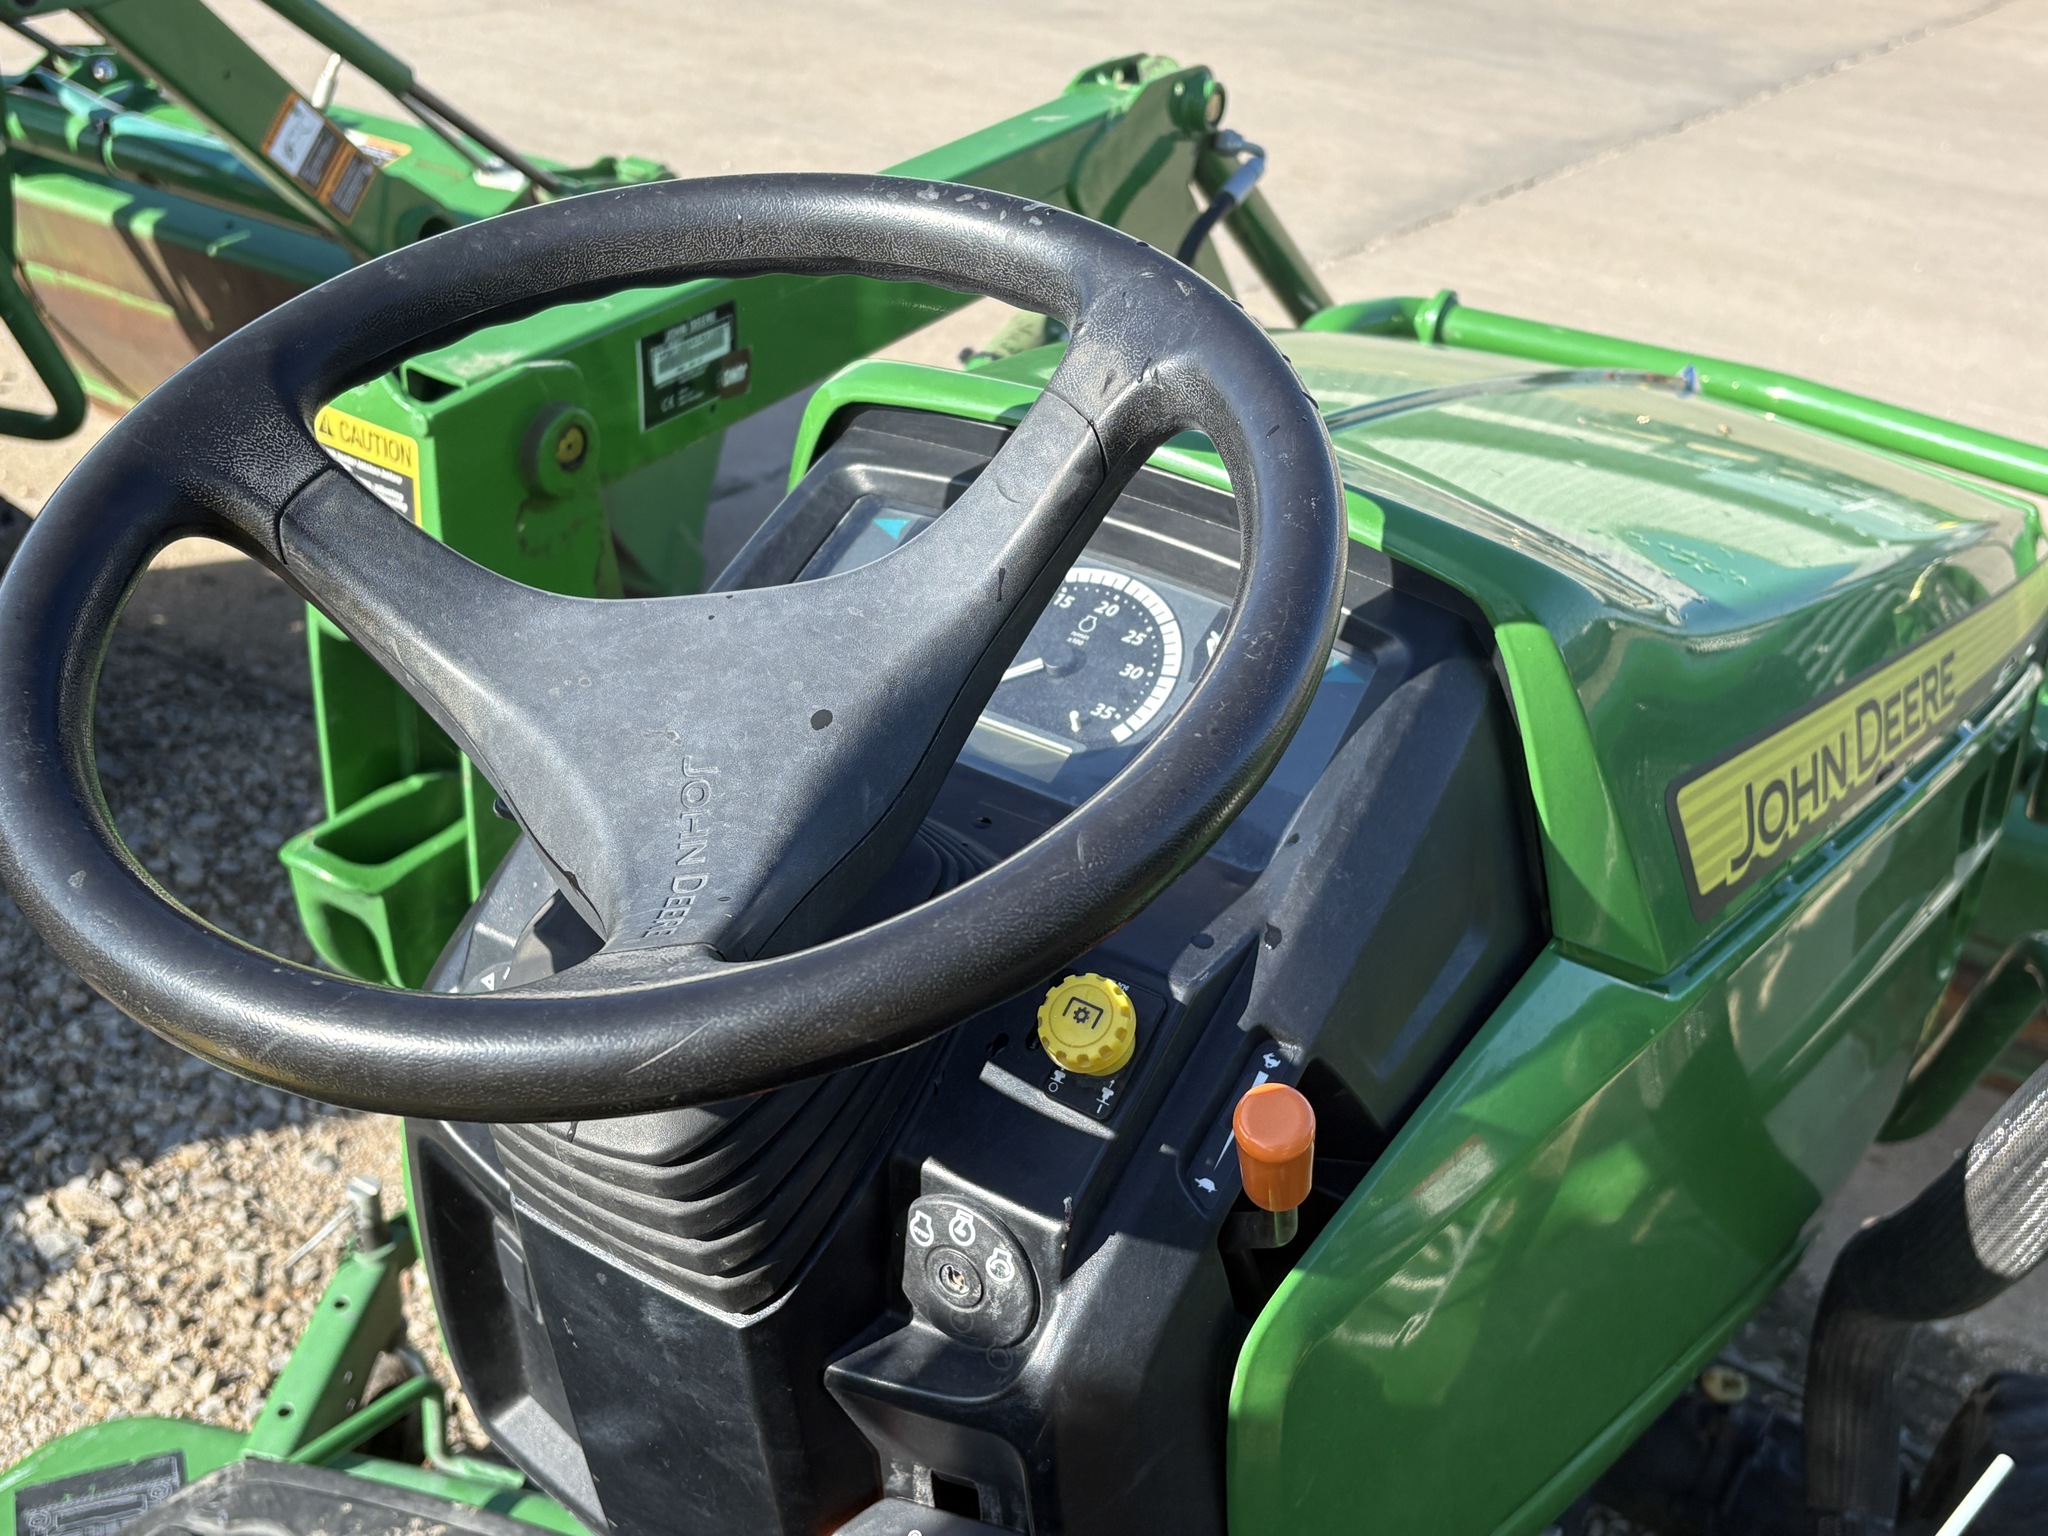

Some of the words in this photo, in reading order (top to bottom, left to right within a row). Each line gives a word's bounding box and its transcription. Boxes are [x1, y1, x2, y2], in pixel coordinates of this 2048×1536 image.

[339, 420, 413, 467] CAUTION
[1053, 594, 1075, 609] 15
[1094, 601, 1120, 617] 20
[1121, 630, 1148, 646] 25
[1119, 664, 1145, 680] 30
[1090, 703, 1116, 719] 35
[1730, 731, 1847, 873] JOHN
[1855, 651, 1956, 779] DEERE
[675, 755, 721, 866] JOHN
[641, 872, 710, 939] DEERE
